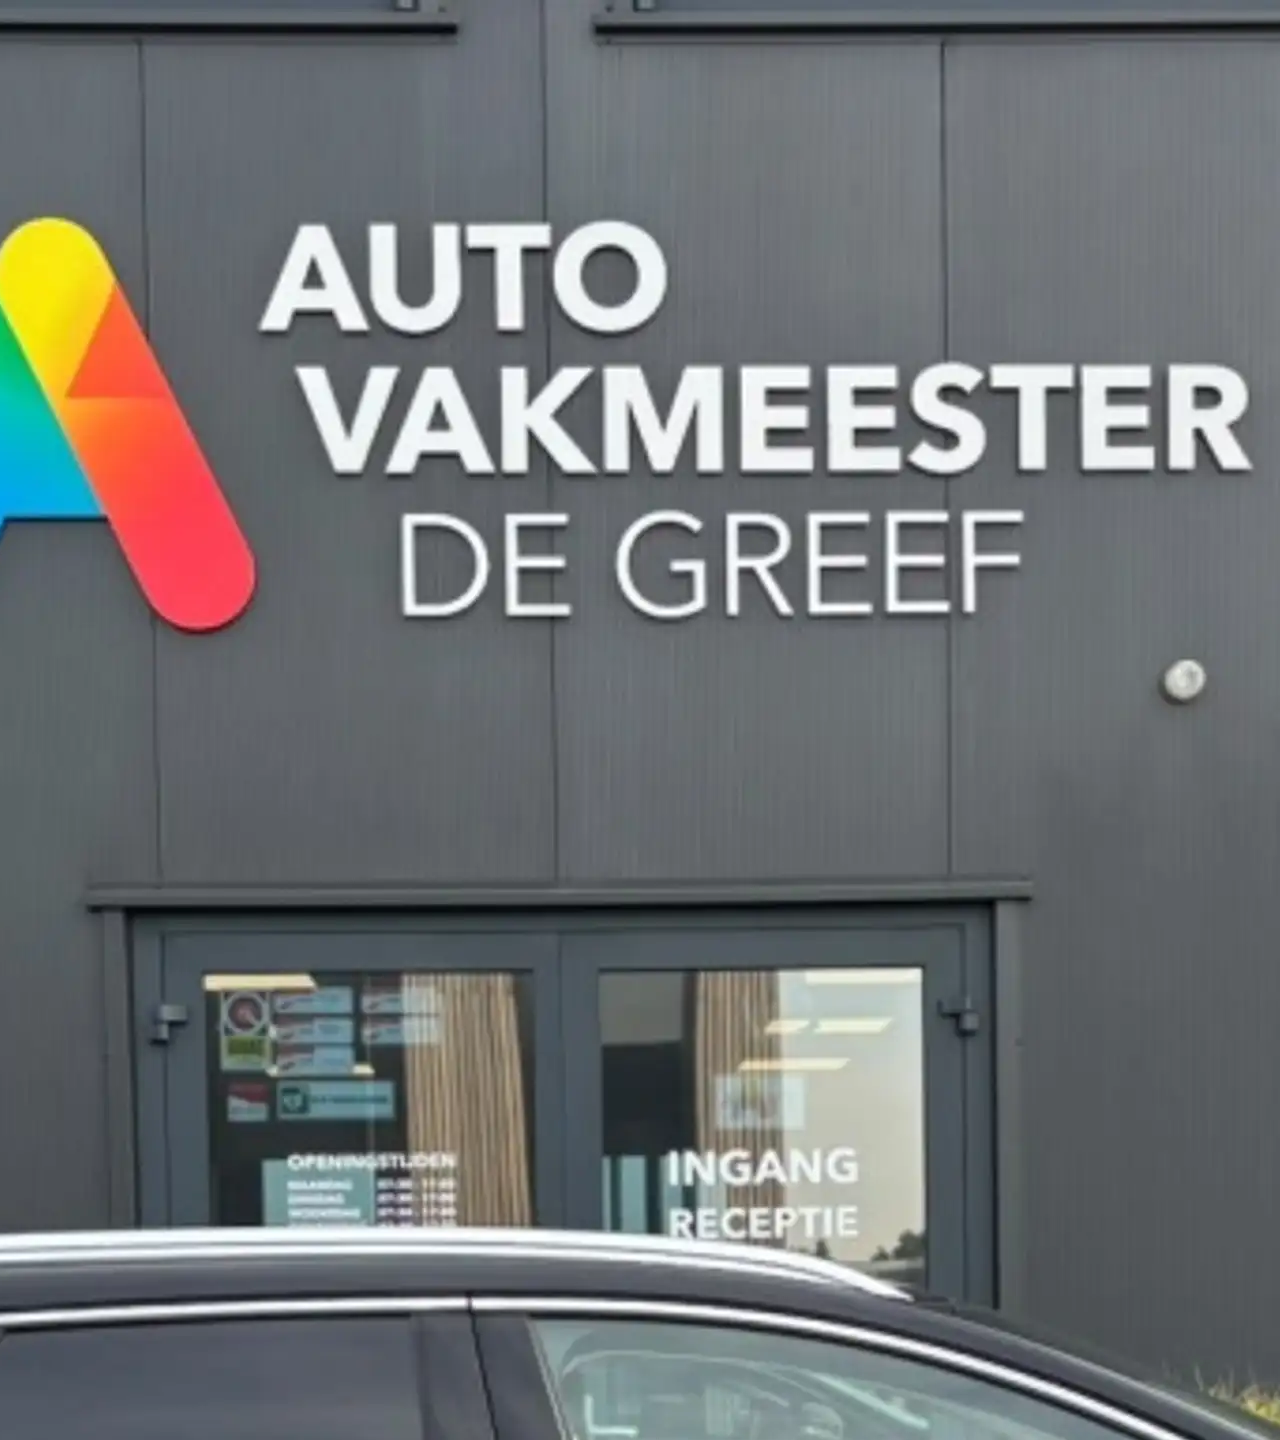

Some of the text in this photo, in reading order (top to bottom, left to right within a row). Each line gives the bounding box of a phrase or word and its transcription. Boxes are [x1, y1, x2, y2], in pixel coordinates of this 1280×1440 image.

[259, 220, 668, 333] AUTO
[295, 361, 1254, 474] VAKMEESTER
[401, 510, 1024, 617] DE GREEF
[669, 1147, 859, 1186] INGANG
[670, 1205, 859, 1239] RECEPTIE
